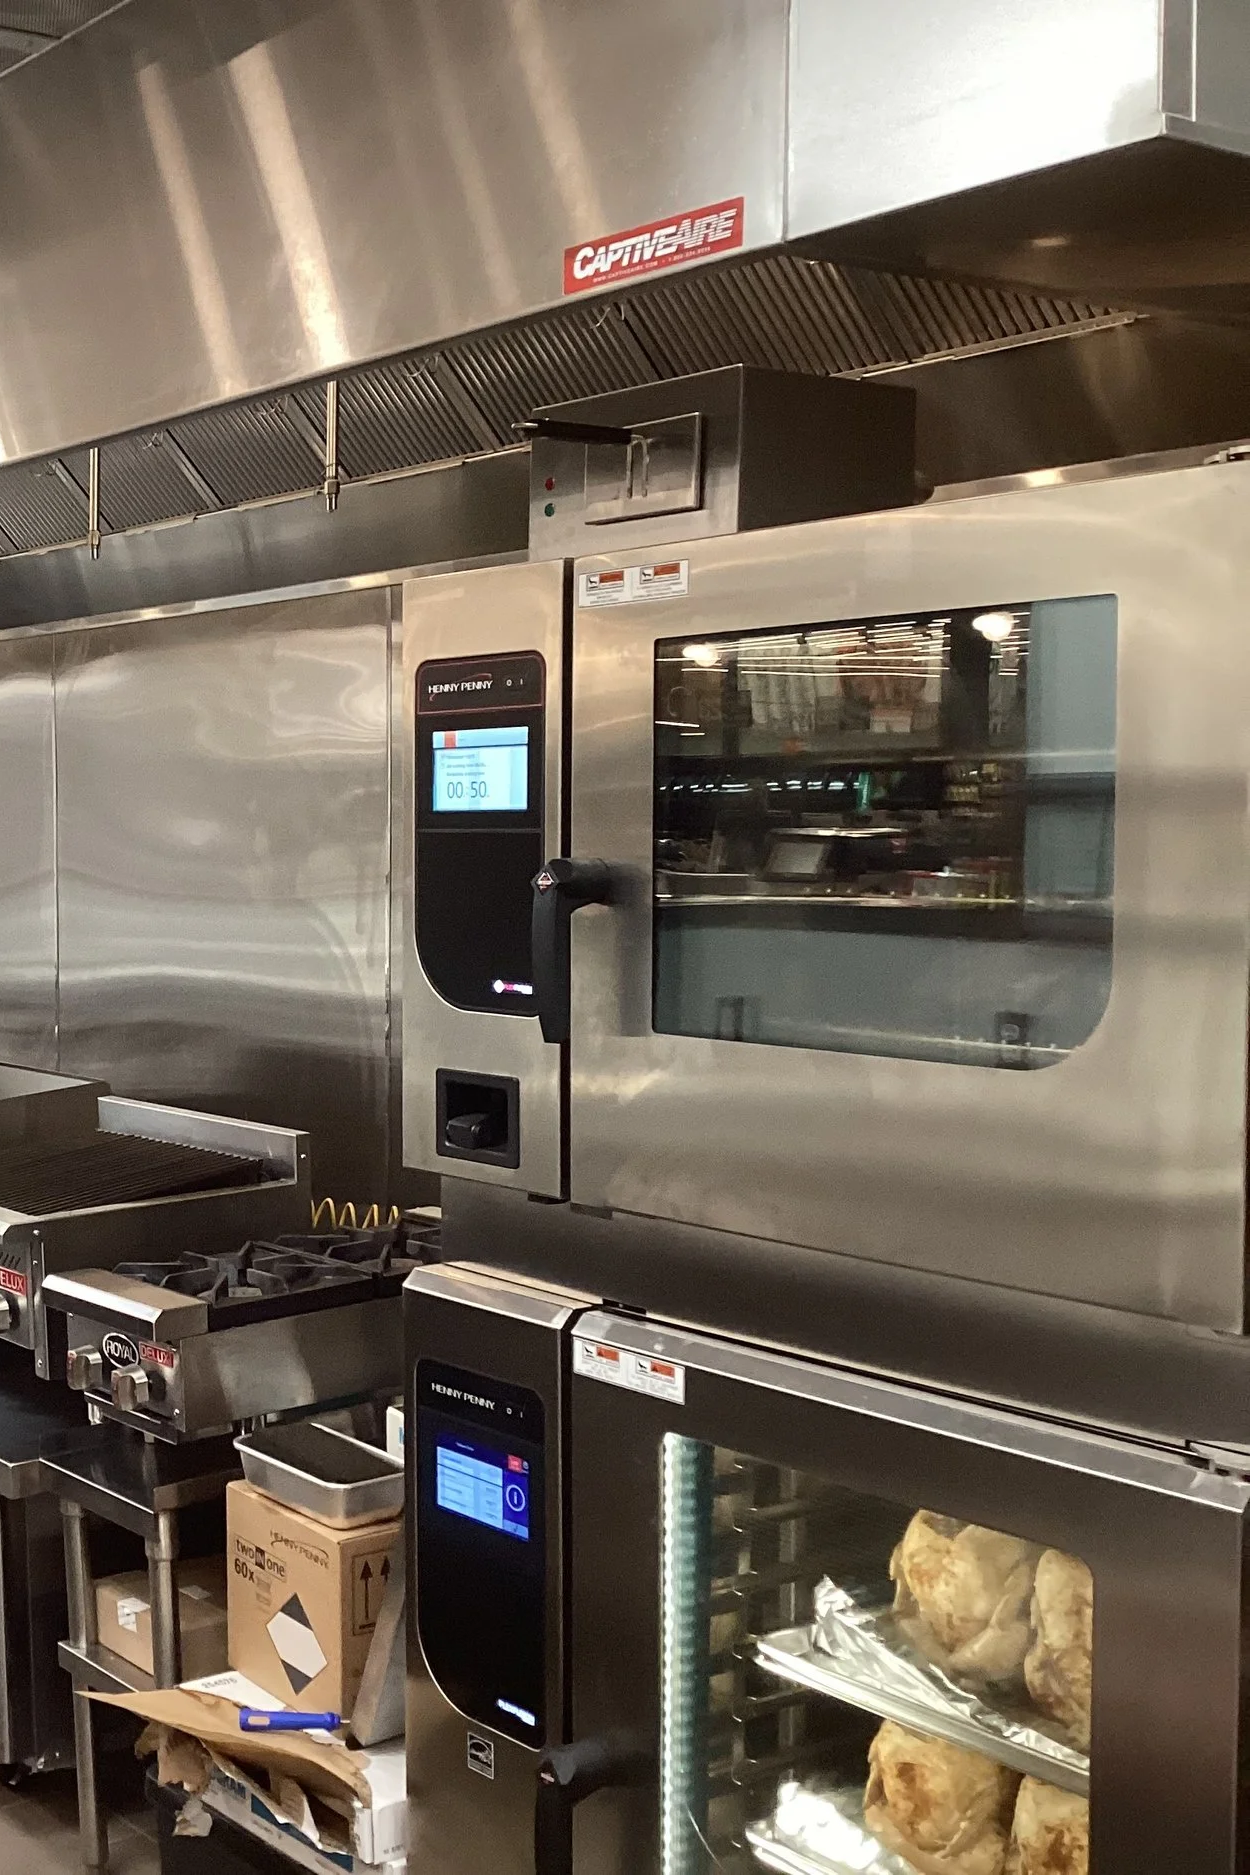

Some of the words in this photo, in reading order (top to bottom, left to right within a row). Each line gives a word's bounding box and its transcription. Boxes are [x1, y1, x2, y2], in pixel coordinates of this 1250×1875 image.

[428, 683, 460, 694] HENNY
[461, 680, 493, 691] PENNY
[106, 1340, 136, 1363] ROYAL
[431, 1382, 463, 1400] HENNY
[464, 1392, 496, 1410] PENNY
